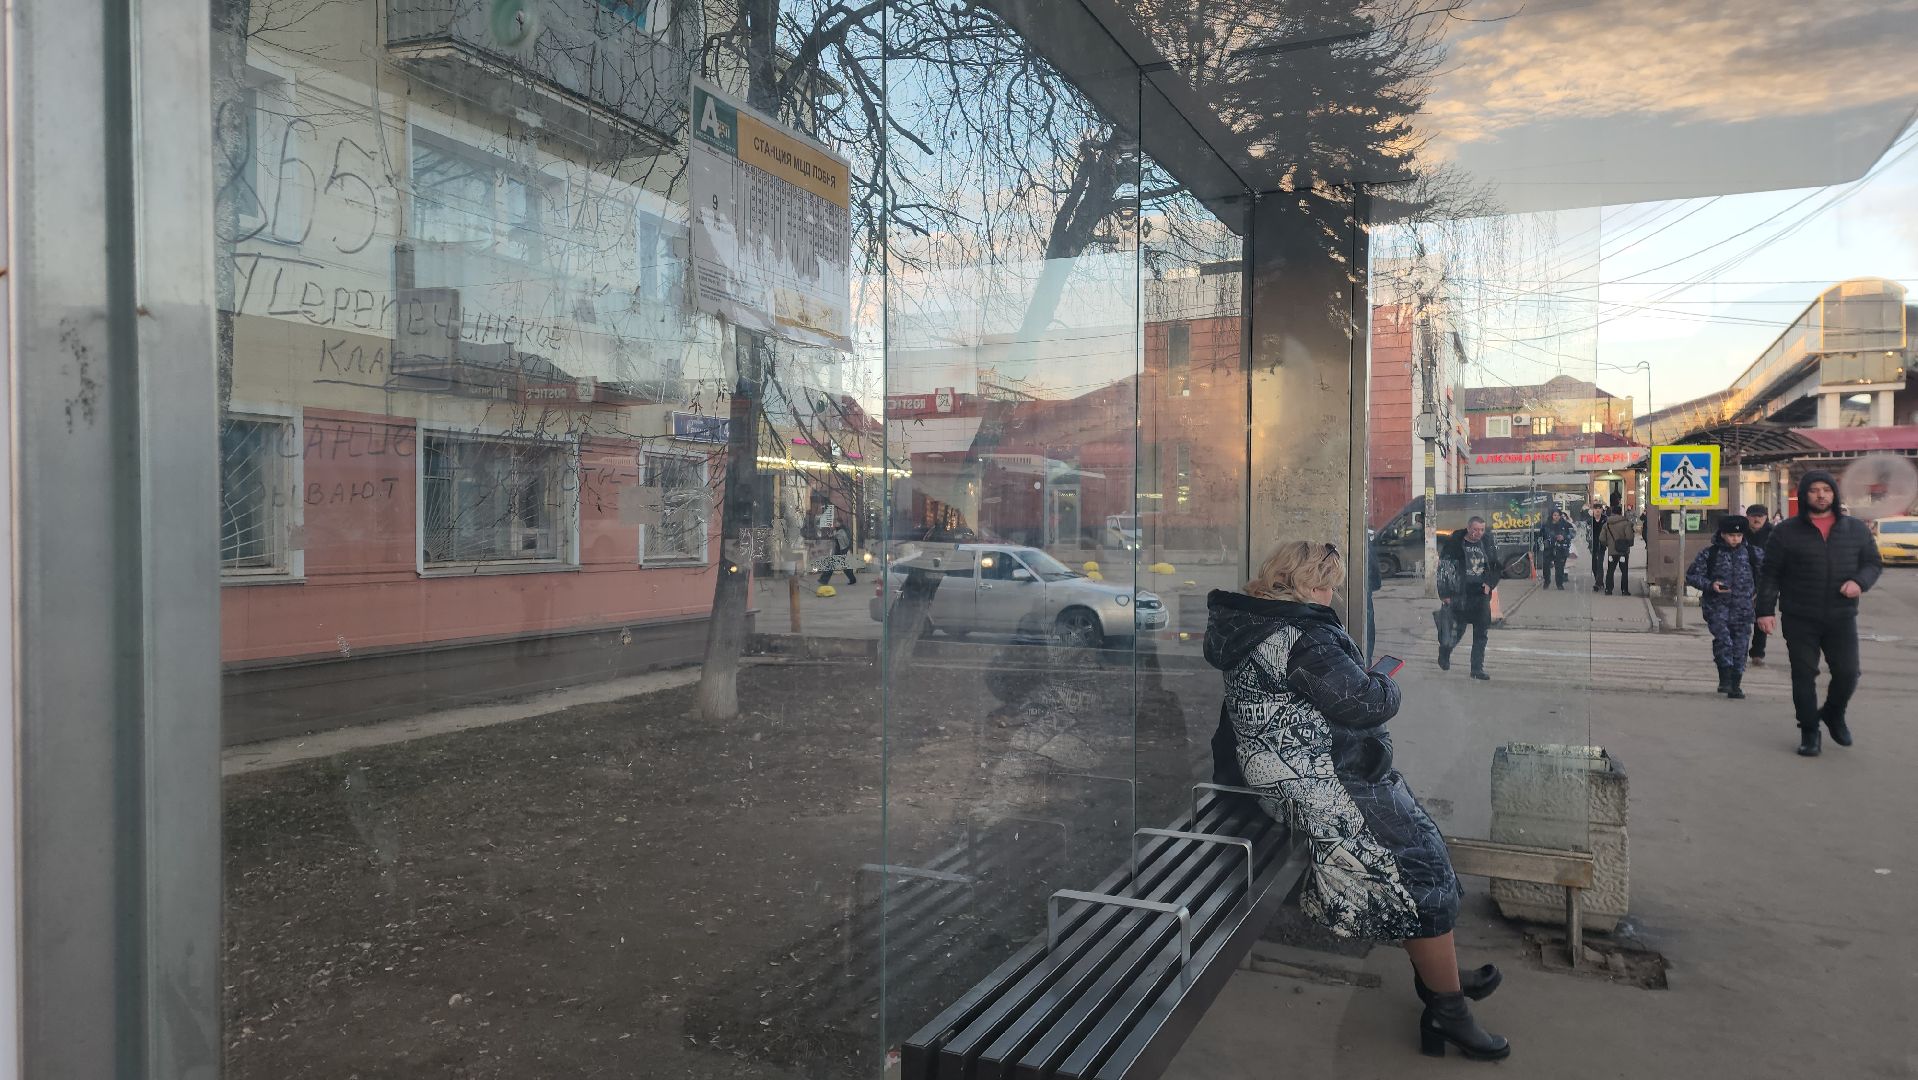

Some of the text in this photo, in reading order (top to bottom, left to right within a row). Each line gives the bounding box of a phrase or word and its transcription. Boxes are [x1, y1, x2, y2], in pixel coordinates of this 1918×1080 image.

[753, 137, 836, 189] СТАНЦИЯ МЦД ЛОБНЯ
[711, 194, 719, 210] 9
[1475, 453, 1569, 465] АЛКОМАРКЕТ
